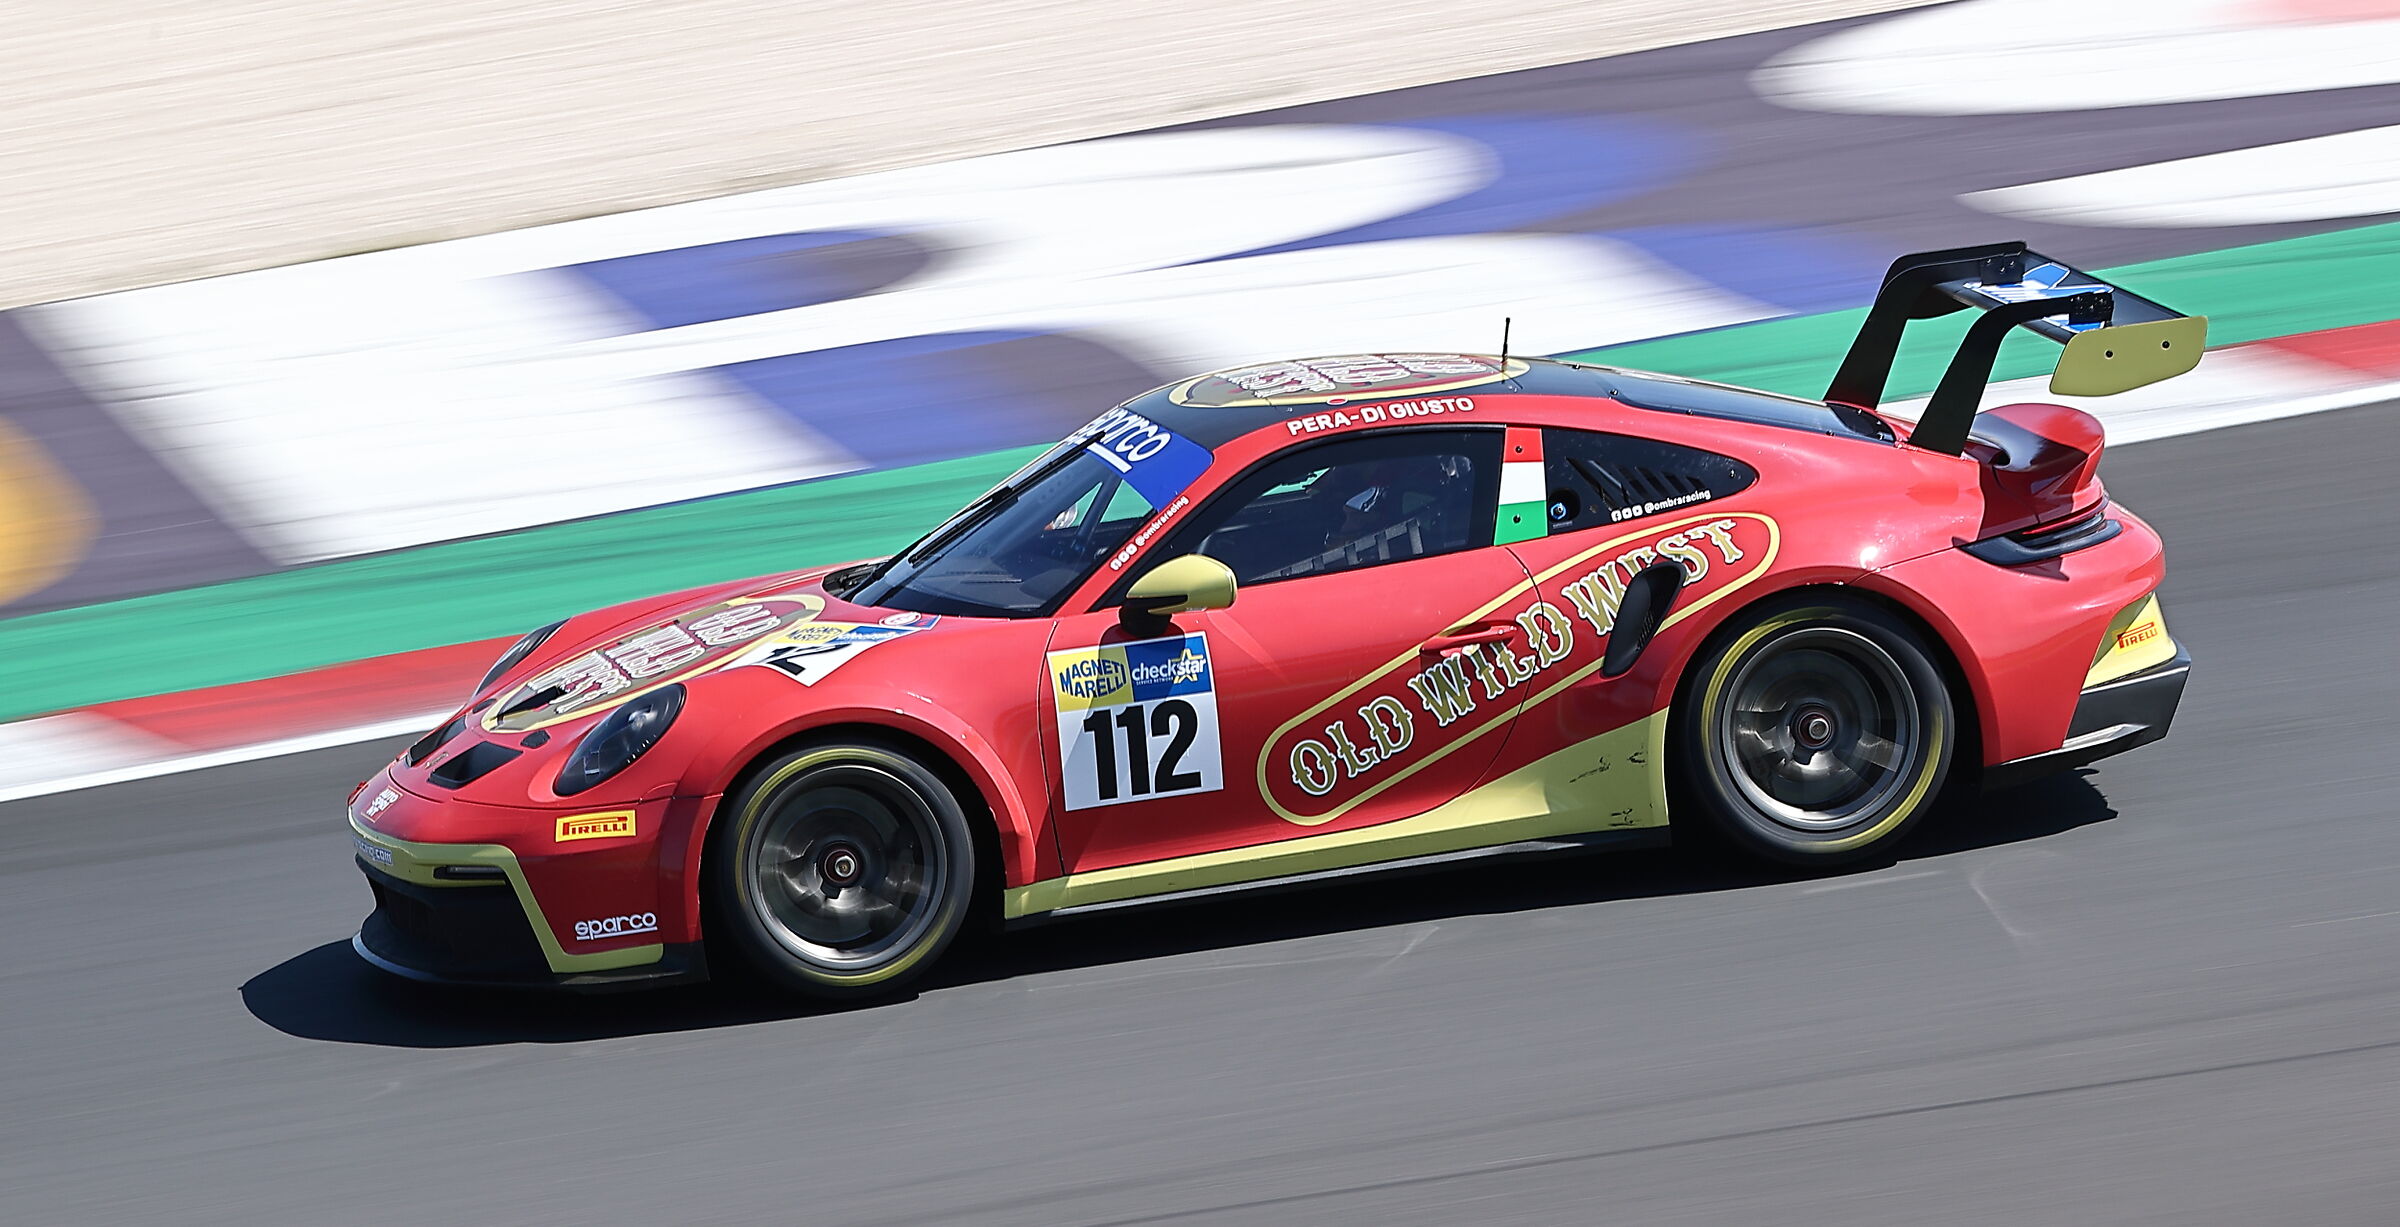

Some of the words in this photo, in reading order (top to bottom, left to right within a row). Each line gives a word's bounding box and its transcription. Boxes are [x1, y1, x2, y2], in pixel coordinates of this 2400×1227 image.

[1388, 397, 1475, 419] GIUSTO
[1644, 489, 1711, 515] @ombraracing
[688, 604, 782, 646] OLD
[2117, 622, 2158, 649] PIRELLI
[604, 623, 706, 679] WILD
[1059, 658, 1127, 695] MAGNETI
[1132, 657, 1206, 682] checkstar
[1059, 671, 1127, 698] MARELLI
[1290, 695, 1414, 796] OLD
[1408, 600, 1574, 727] WILD
[1083, 699, 1202, 801] 112
[562, 816, 628, 836] PIRELLI
[575, 912, 658, 940] sparco
